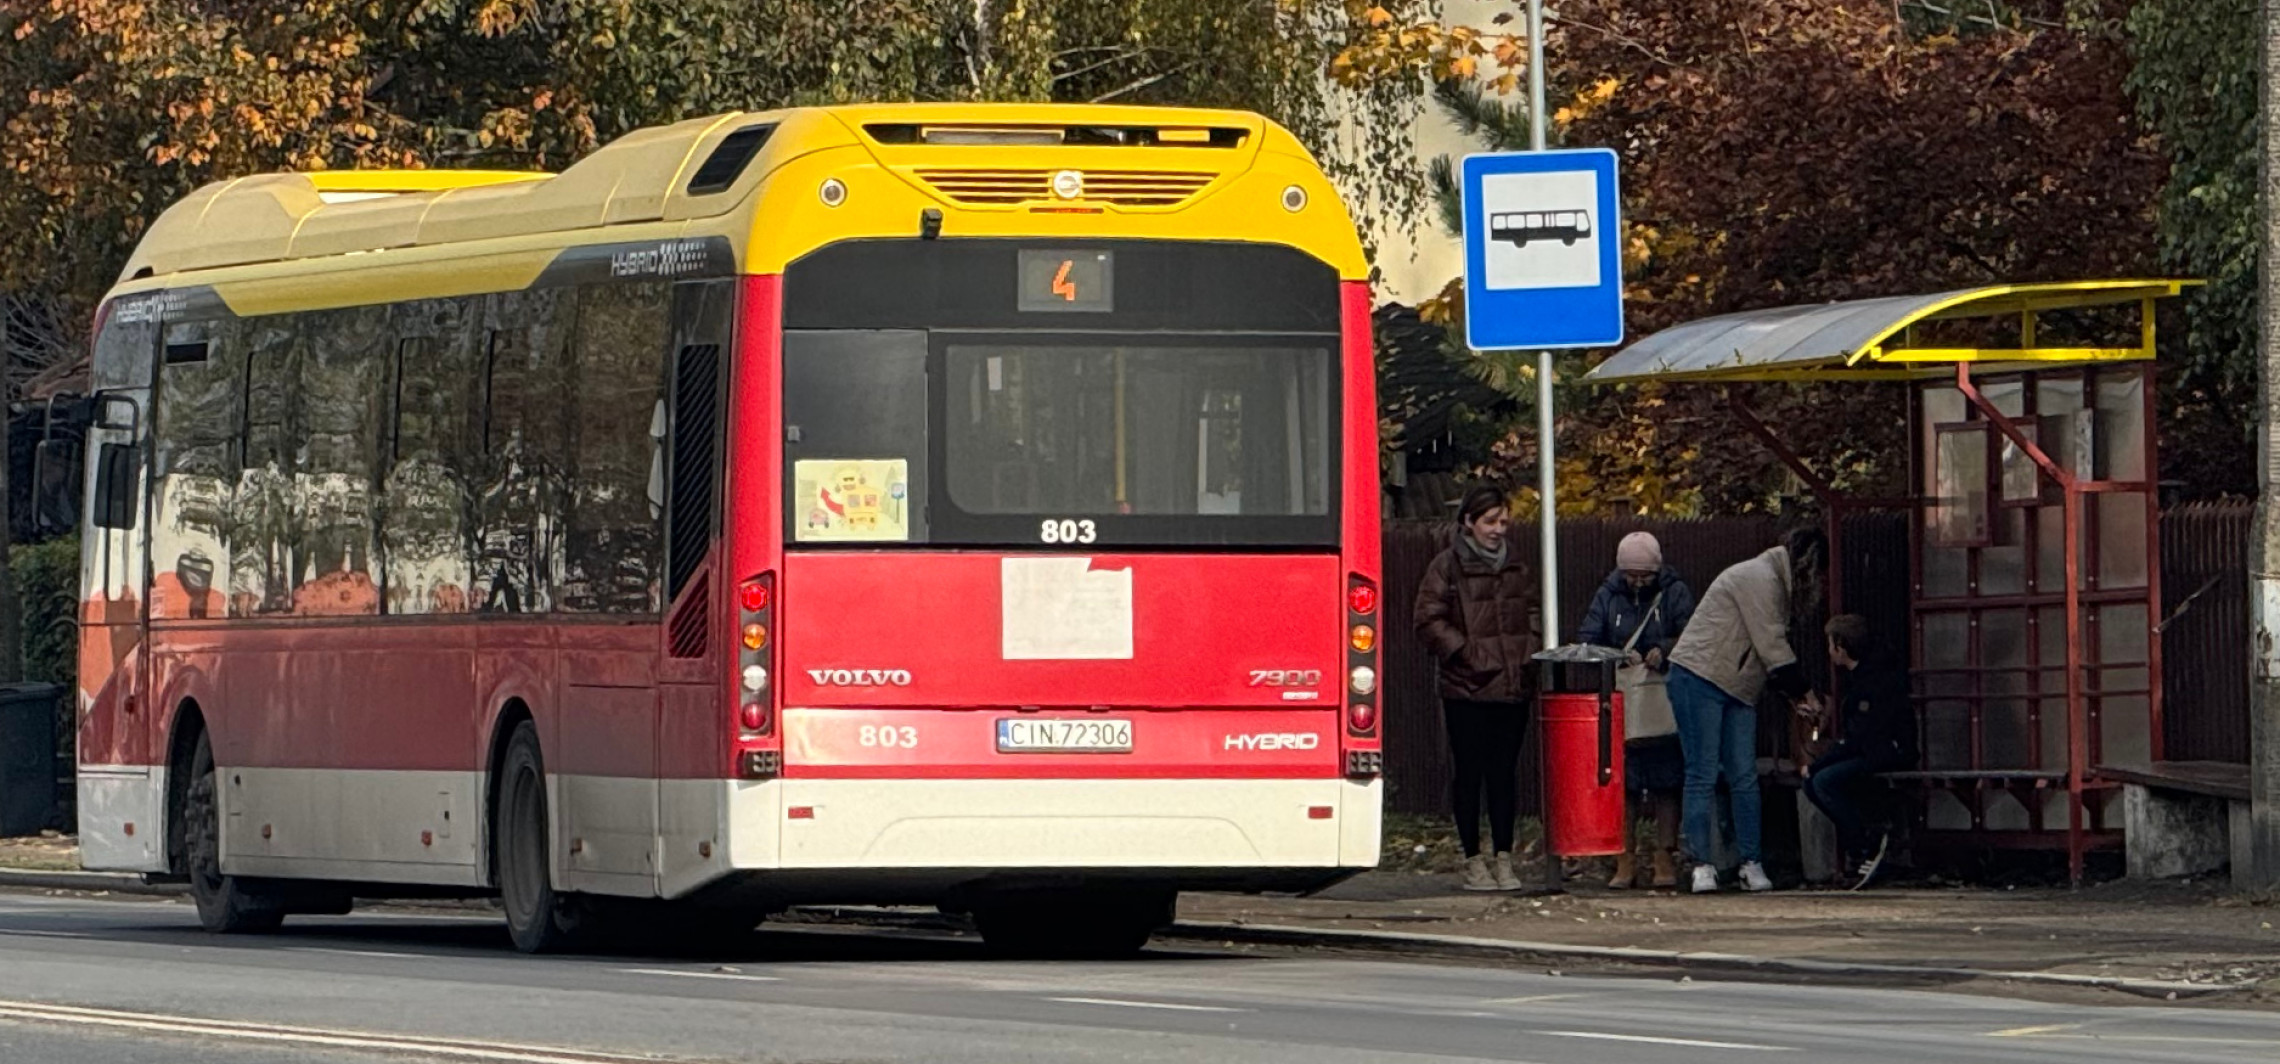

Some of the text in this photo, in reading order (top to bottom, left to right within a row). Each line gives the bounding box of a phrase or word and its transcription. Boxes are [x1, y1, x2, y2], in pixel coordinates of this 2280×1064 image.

[611, 250, 658, 277] HYBRID
[1052, 259, 1075, 301] 4
[1041, 519, 1097, 544] 803
[807, 669, 912, 686] VOLVO
[1249, 669, 1322, 687] 7900
[858, 725, 918, 748] 803
[1011, 722, 1129, 745] CIN 72306
[1224, 733, 1319, 750] HYBRID
